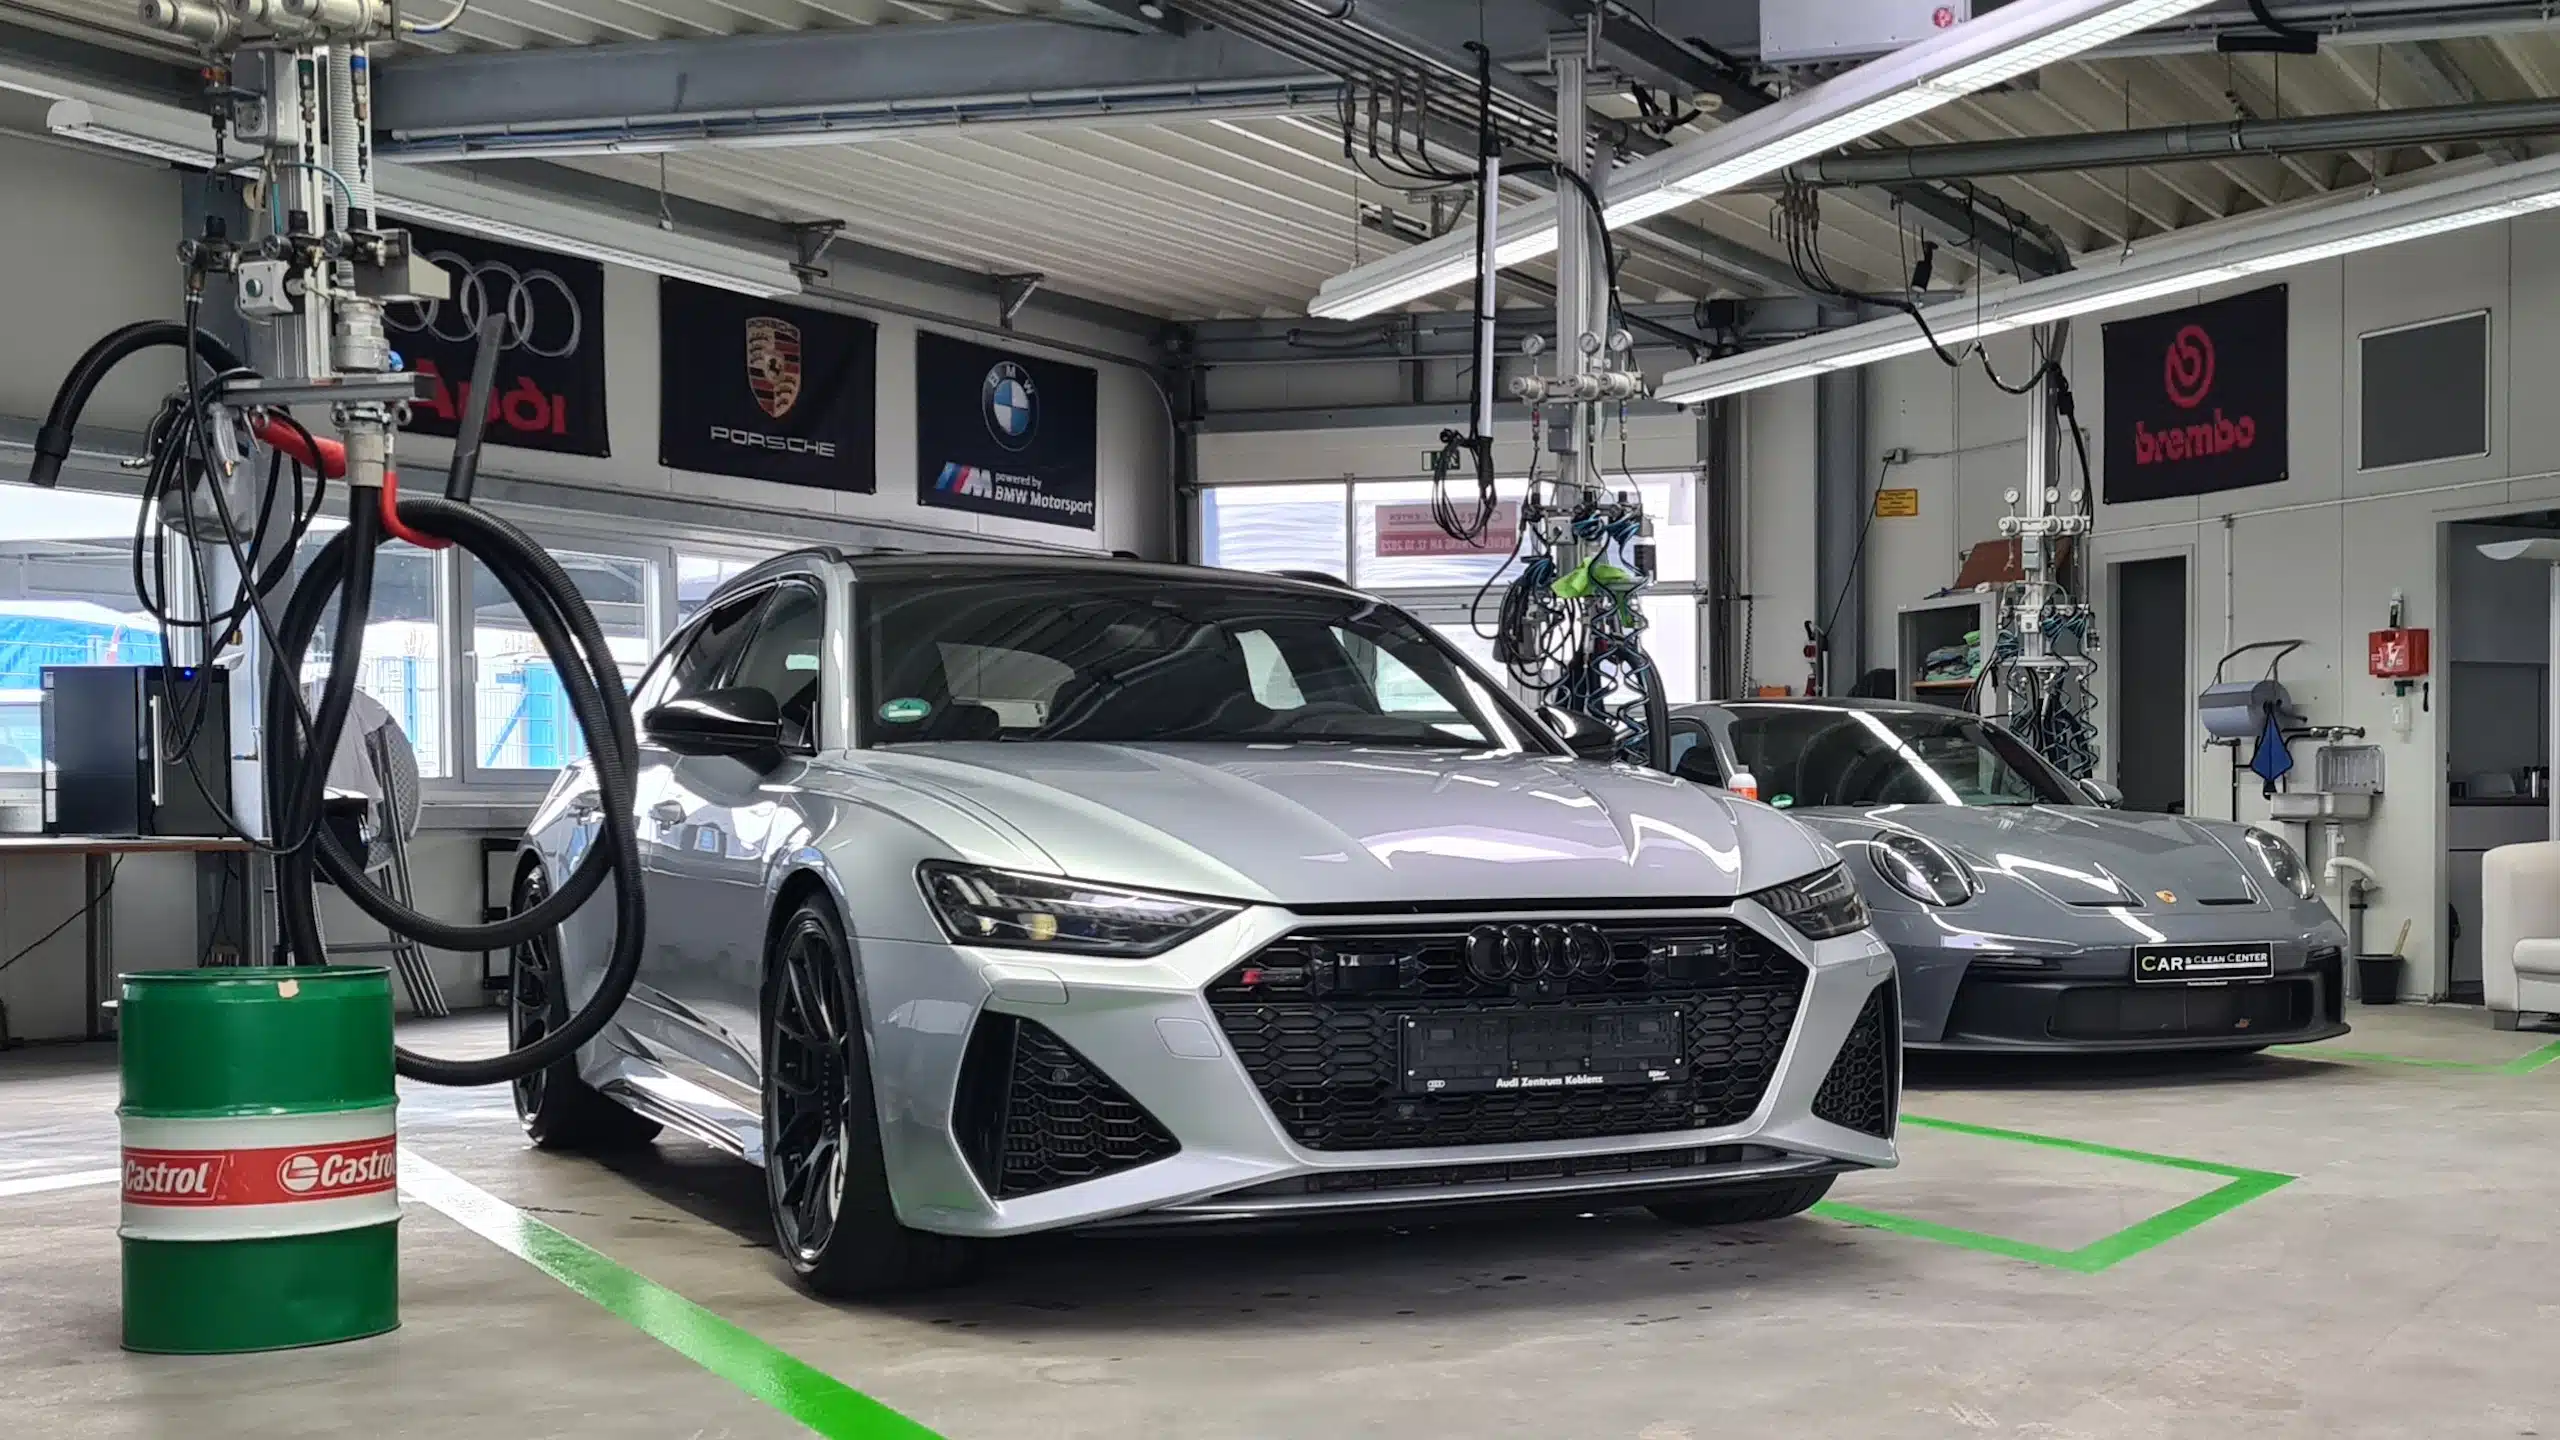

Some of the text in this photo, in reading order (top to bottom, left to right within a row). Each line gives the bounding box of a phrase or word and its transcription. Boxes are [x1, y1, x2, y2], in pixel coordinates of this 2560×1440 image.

[987, 365, 1035, 395] BMW
[710, 426, 836, 458] PORSCHE
[2136, 408, 2256, 465] brembo
[995, 472, 1042, 490] powered by
[995, 485, 1093, 515] BMW Motorsport
[2141, 956, 2184, 971] CAR
[2193, 955, 2226, 964] CLEAN
[2227, 953, 2268, 963] CENTER
[1496, 1075, 1604, 1088] Audi Zentrum Koblenz
[125, 1159, 210, 1194] Castrol
